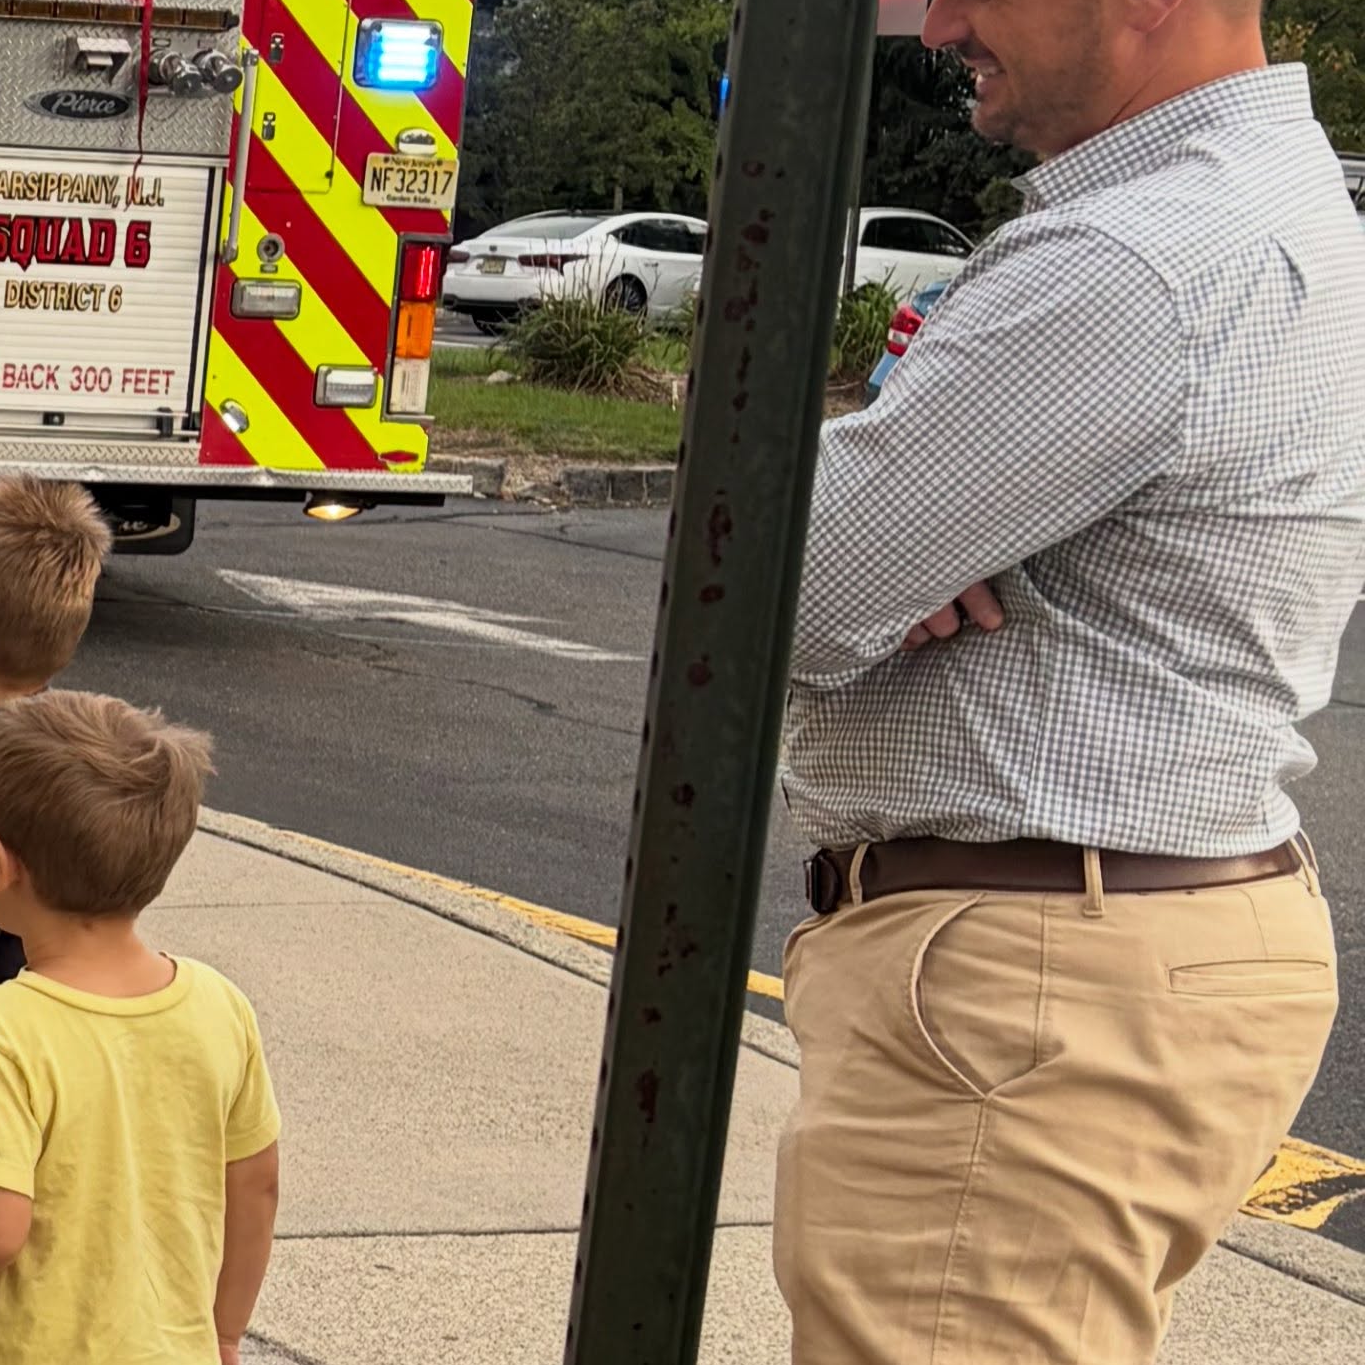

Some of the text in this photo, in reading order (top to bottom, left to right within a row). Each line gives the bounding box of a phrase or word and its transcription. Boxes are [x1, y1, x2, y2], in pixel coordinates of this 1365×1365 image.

[50, 89, 116, 114] Pierce
[125, 176, 164, 208] N.J.
[370, 167, 453, 195] NF32317
[124, 220, 151, 268] 6
[4, 280, 122, 313] DISTRICT 6
[2, 363, 60, 391] BACK
[69, 365, 113, 393] 300
[121, 367, 175, 395] FEET
